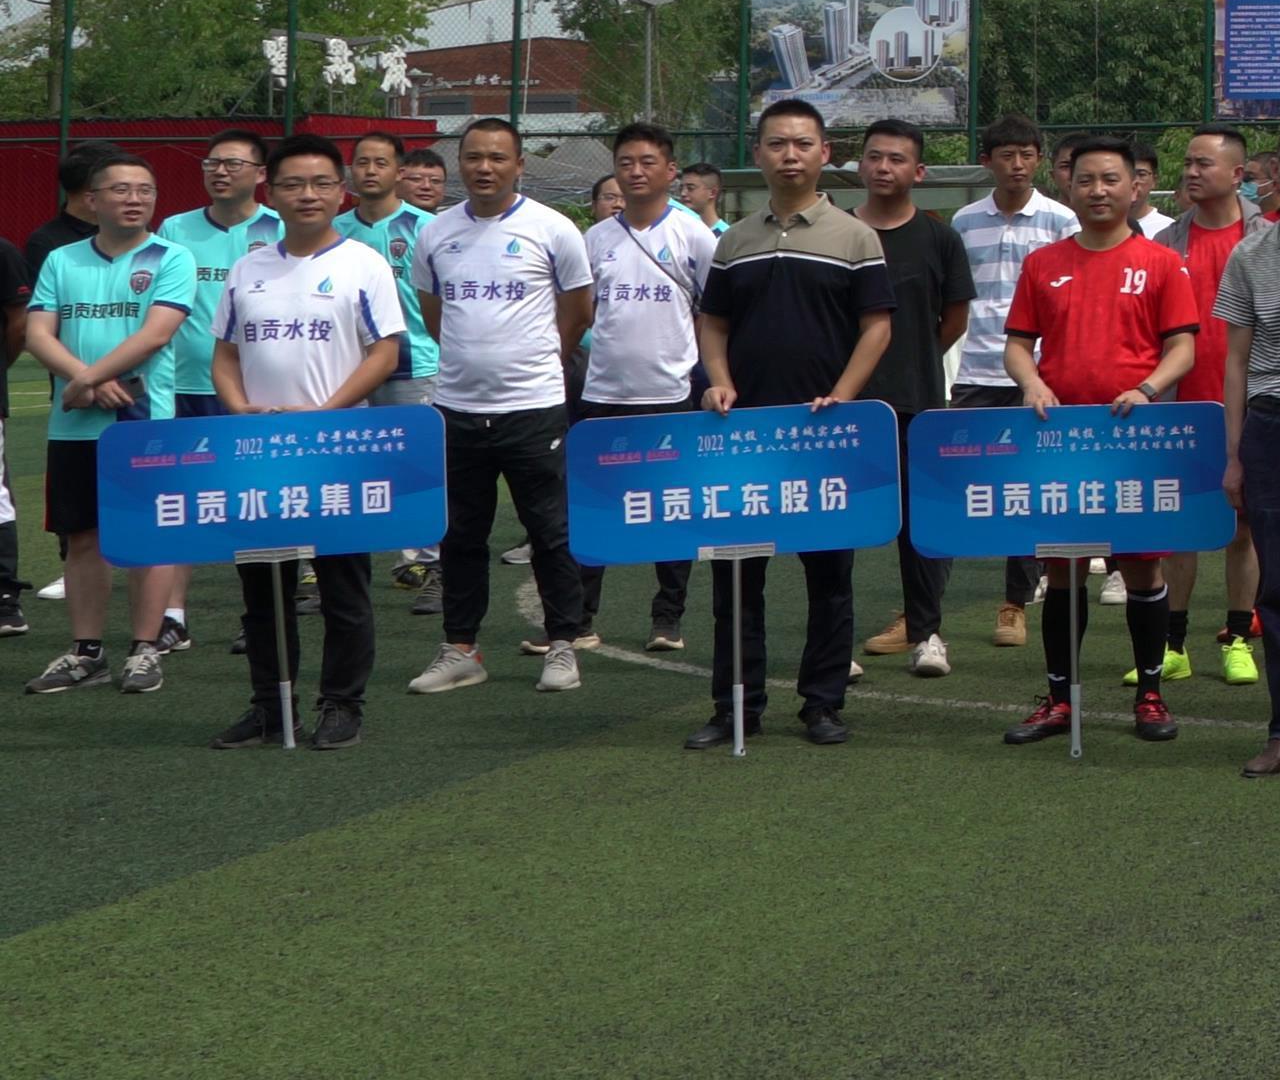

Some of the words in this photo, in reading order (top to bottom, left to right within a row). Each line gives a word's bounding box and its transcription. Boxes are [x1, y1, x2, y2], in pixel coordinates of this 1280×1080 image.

[444, 280, 527, 301] 自贡水投
[1120, 267, 1147, 296] 19
[60, 302, 141, 320] 自贡规划院
[243, 319, 333, 343] 自贡水投
[234, 437, 264, 455] 2022
[697, 434, 725, 453] 2022
[1036, 430, 1063, 448] 2022
[155, 480, 392, 527] 自贡水投集团
[622, 477, 848, 525] 自贡汇东股份
[965, 479, 1181, 518] 自贡市住建局
